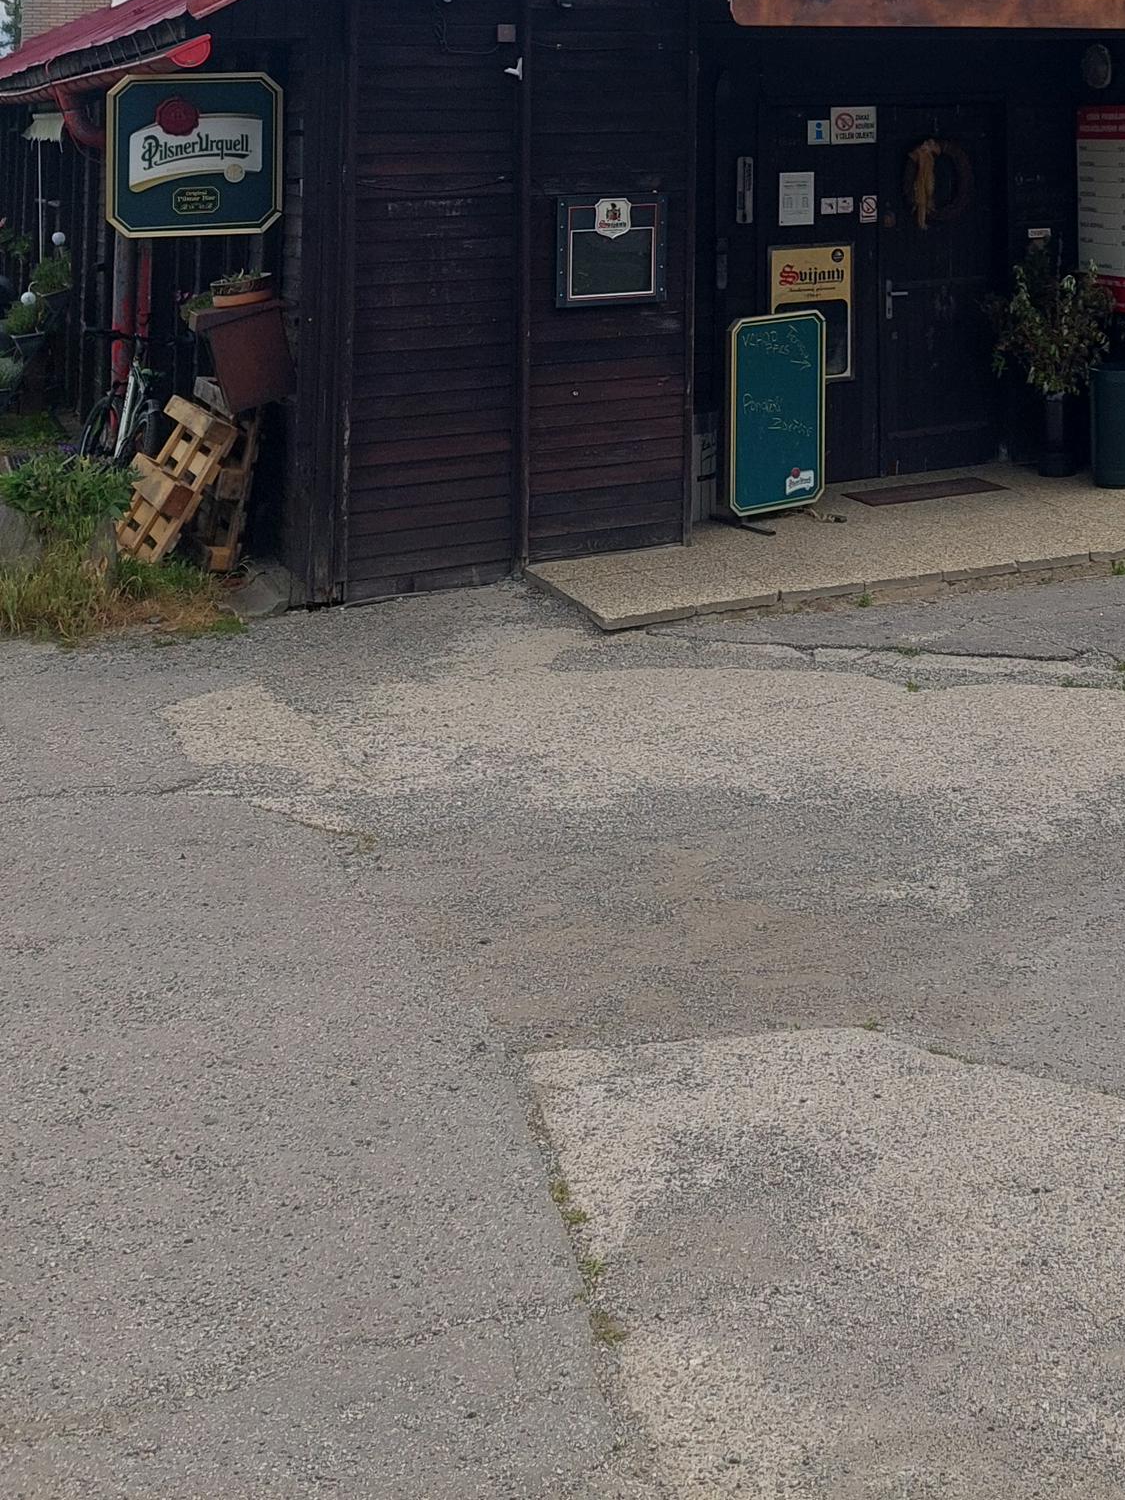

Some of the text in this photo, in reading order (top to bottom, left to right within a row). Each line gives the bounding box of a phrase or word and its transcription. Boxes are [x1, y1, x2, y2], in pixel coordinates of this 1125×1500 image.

[141, 132, 250, 170] Pilsner Urquell
[779, 264, 845, 286] Svijany
